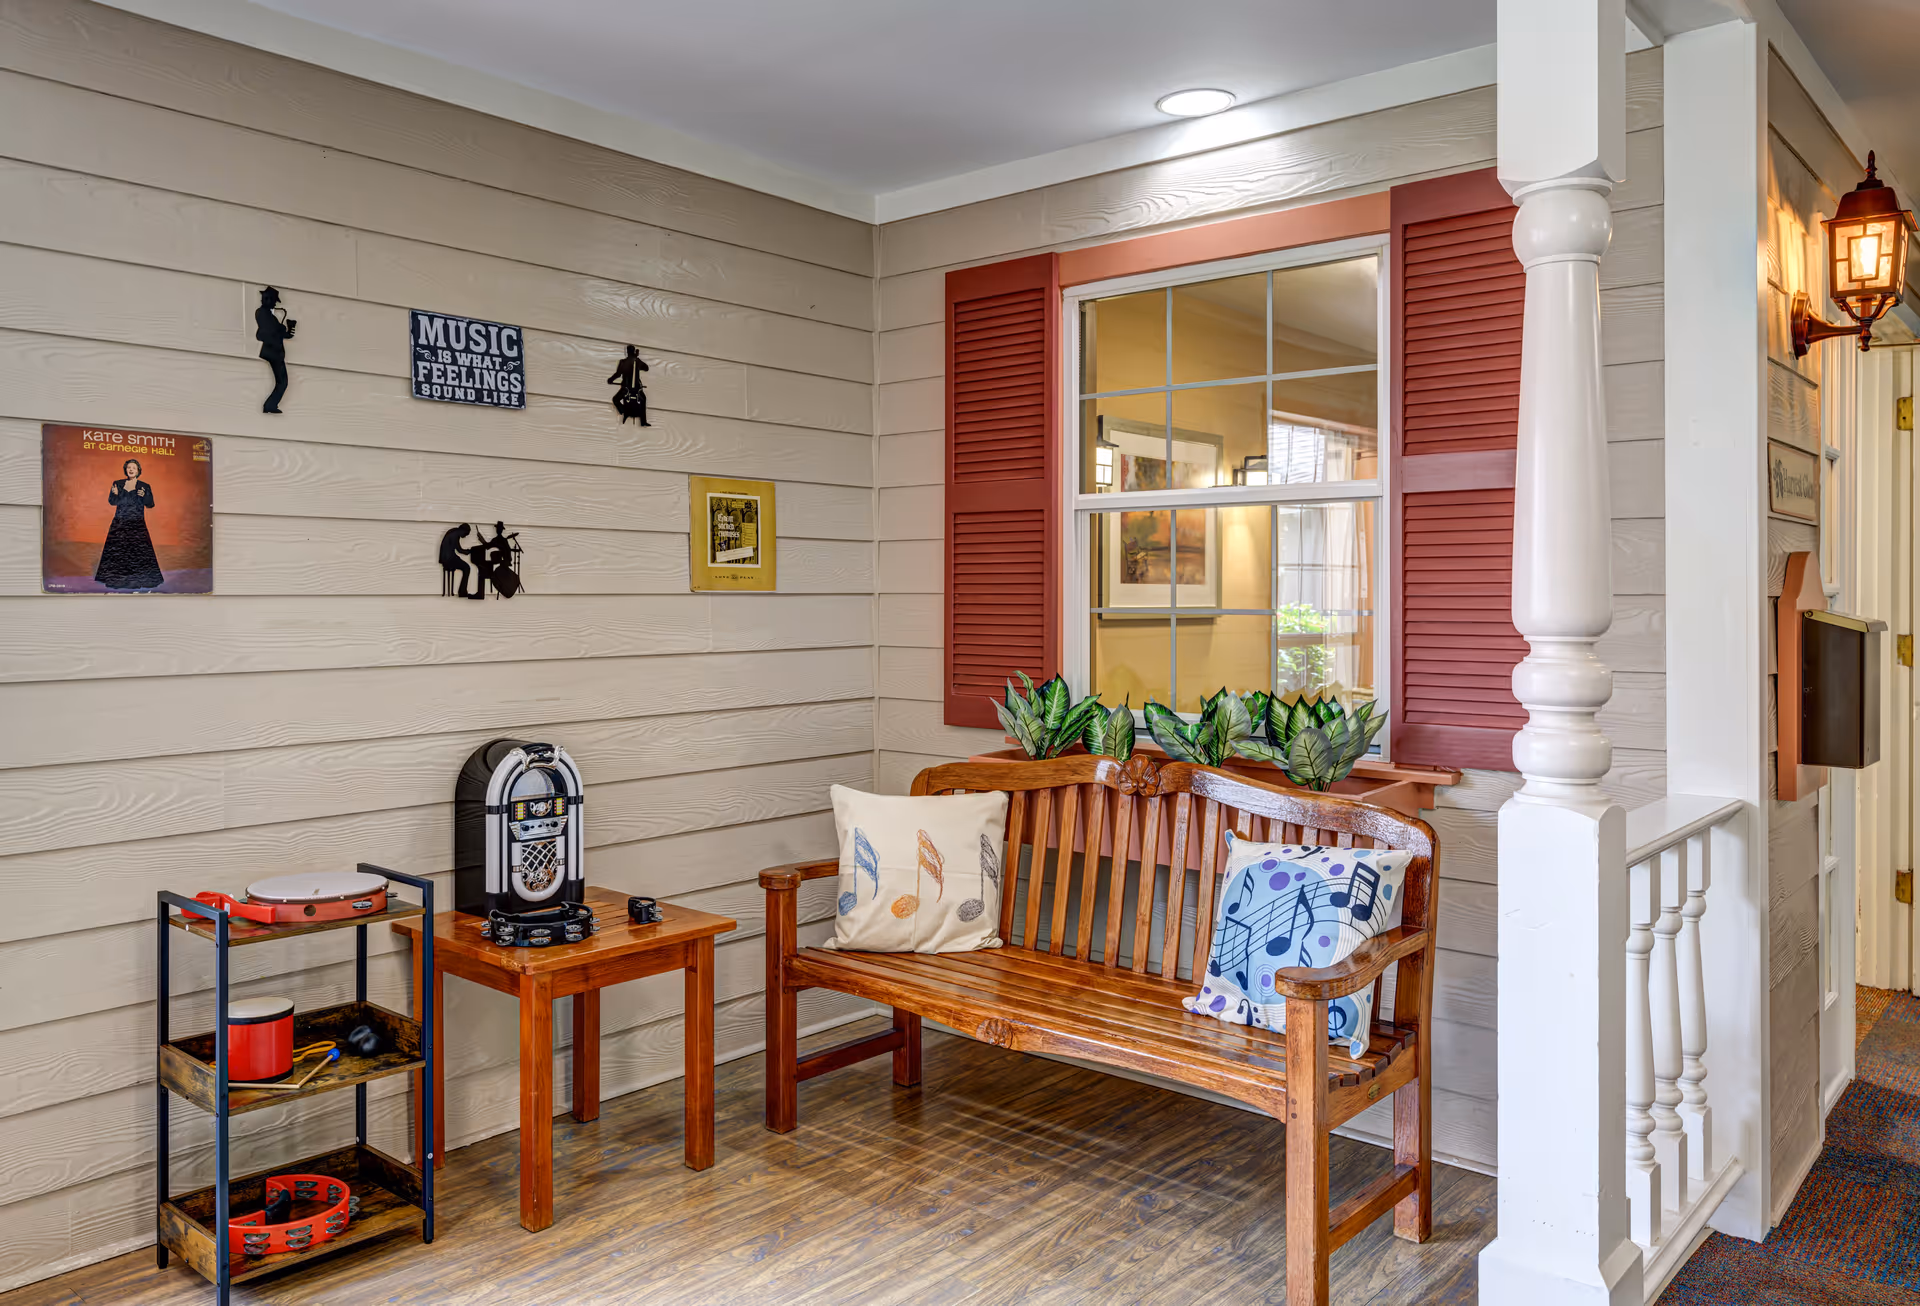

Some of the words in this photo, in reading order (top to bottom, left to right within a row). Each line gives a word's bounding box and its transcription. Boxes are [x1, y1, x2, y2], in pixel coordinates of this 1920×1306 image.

[417, 315, 518, 358] MUSIC
[437, 349, 452, 364] IS
[455, 352, 502, 370] WHAT
[417, 361, 522, 393] FEELINGS
[421, 383, 476, 401] SOUND
[483, 391, 519, 406] LIKE
